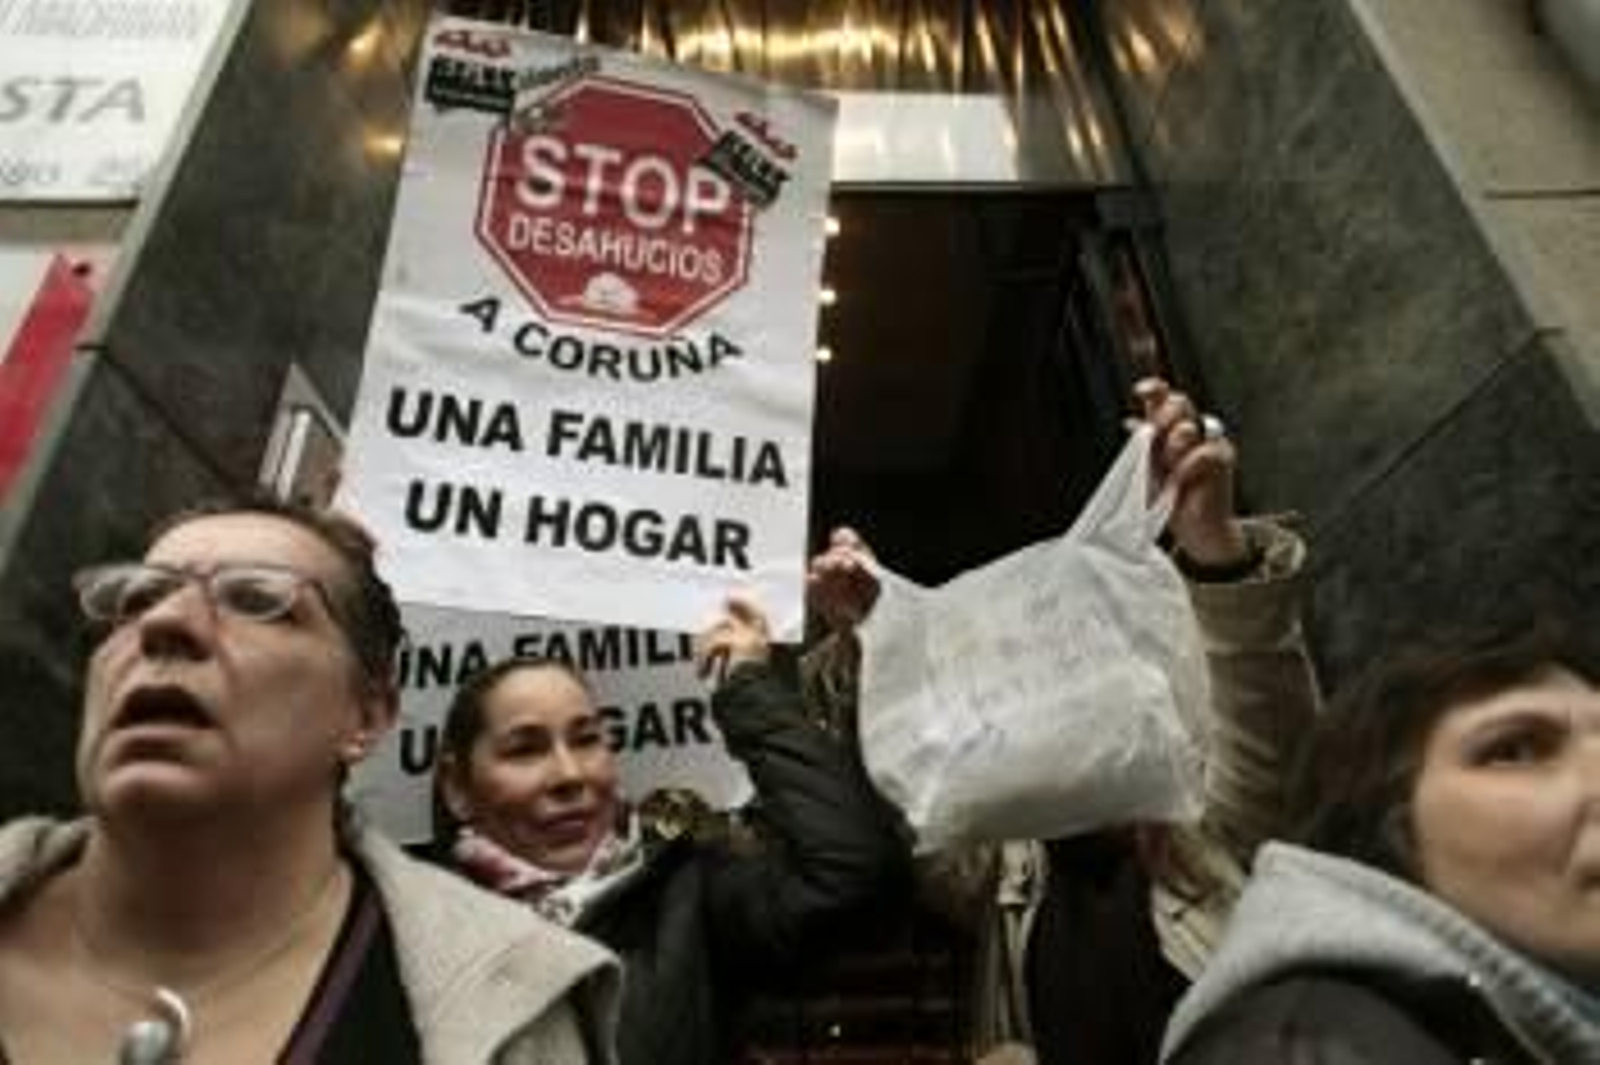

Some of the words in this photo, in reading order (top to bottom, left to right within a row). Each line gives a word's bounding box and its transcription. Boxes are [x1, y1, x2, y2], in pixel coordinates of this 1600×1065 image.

[516, 135, 732, 234] STOP
[507, 214, 723, 285] DESAHUCIOS
[459, 295, 501, 333] A
[386, 386, 523, 452] UNA
[546, 409, 788, 489] FAMILIA
[404, 480, 502, 539] UN
[523, 496, 752, 571] HOGAR
